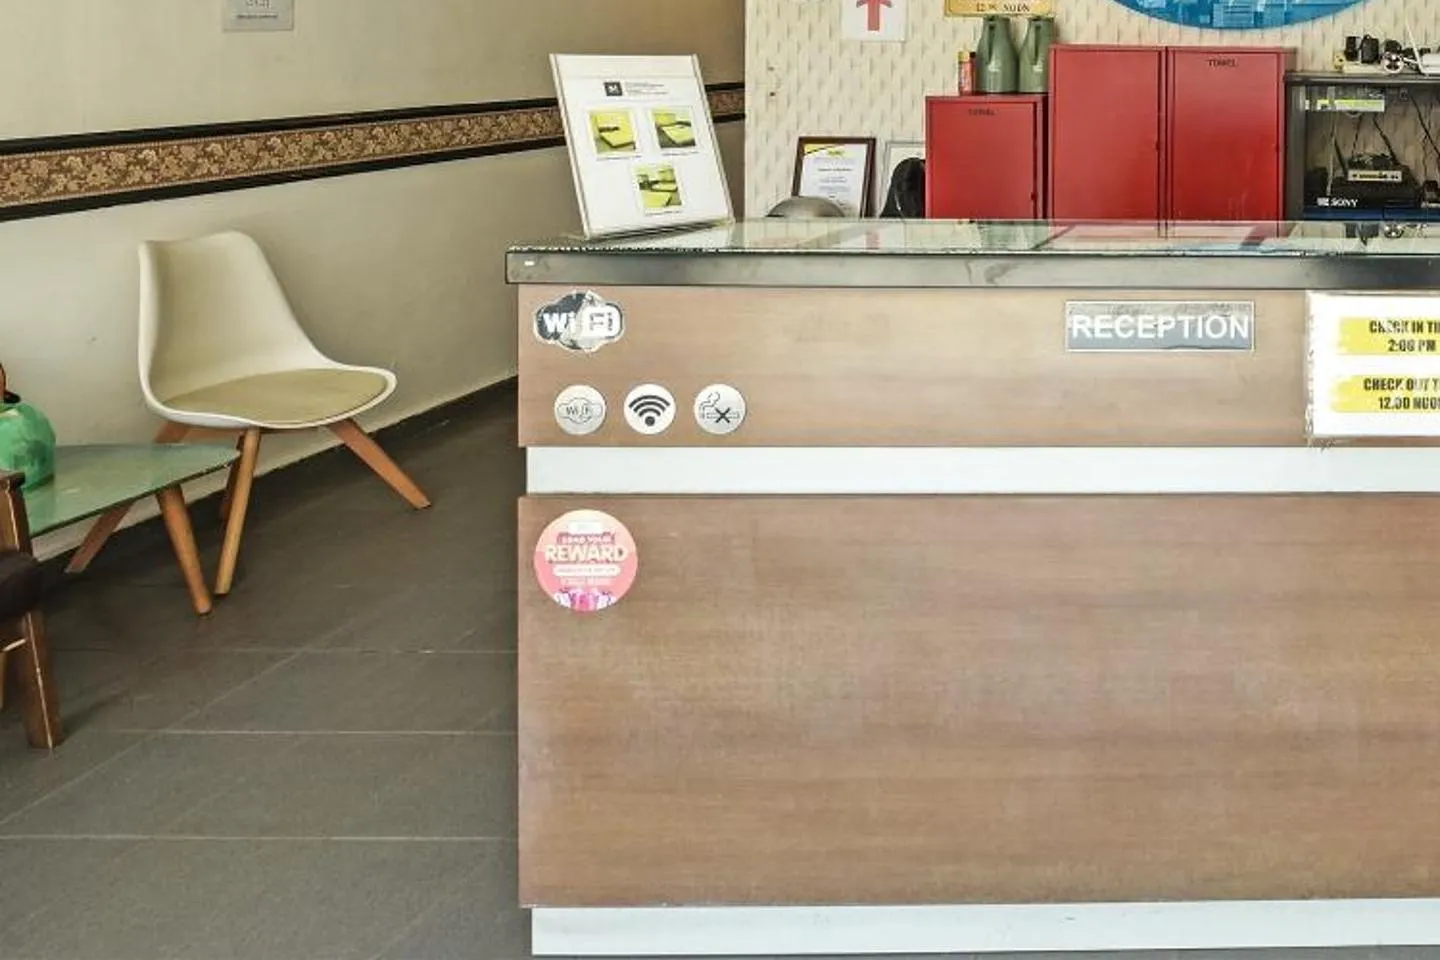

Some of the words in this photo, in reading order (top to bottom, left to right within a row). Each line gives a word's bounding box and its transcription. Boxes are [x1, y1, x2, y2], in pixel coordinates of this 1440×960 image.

[1072, 313, 1249, 339] RECEPTION
[1412, 321, 1423, 333] IN
[1419, 339, 1436, 352] PM
[1364, 378, 1404, 391] CHECK
[1406, 378, 1430, 391] OUT
[544, 544, 629, 563] REWARD
